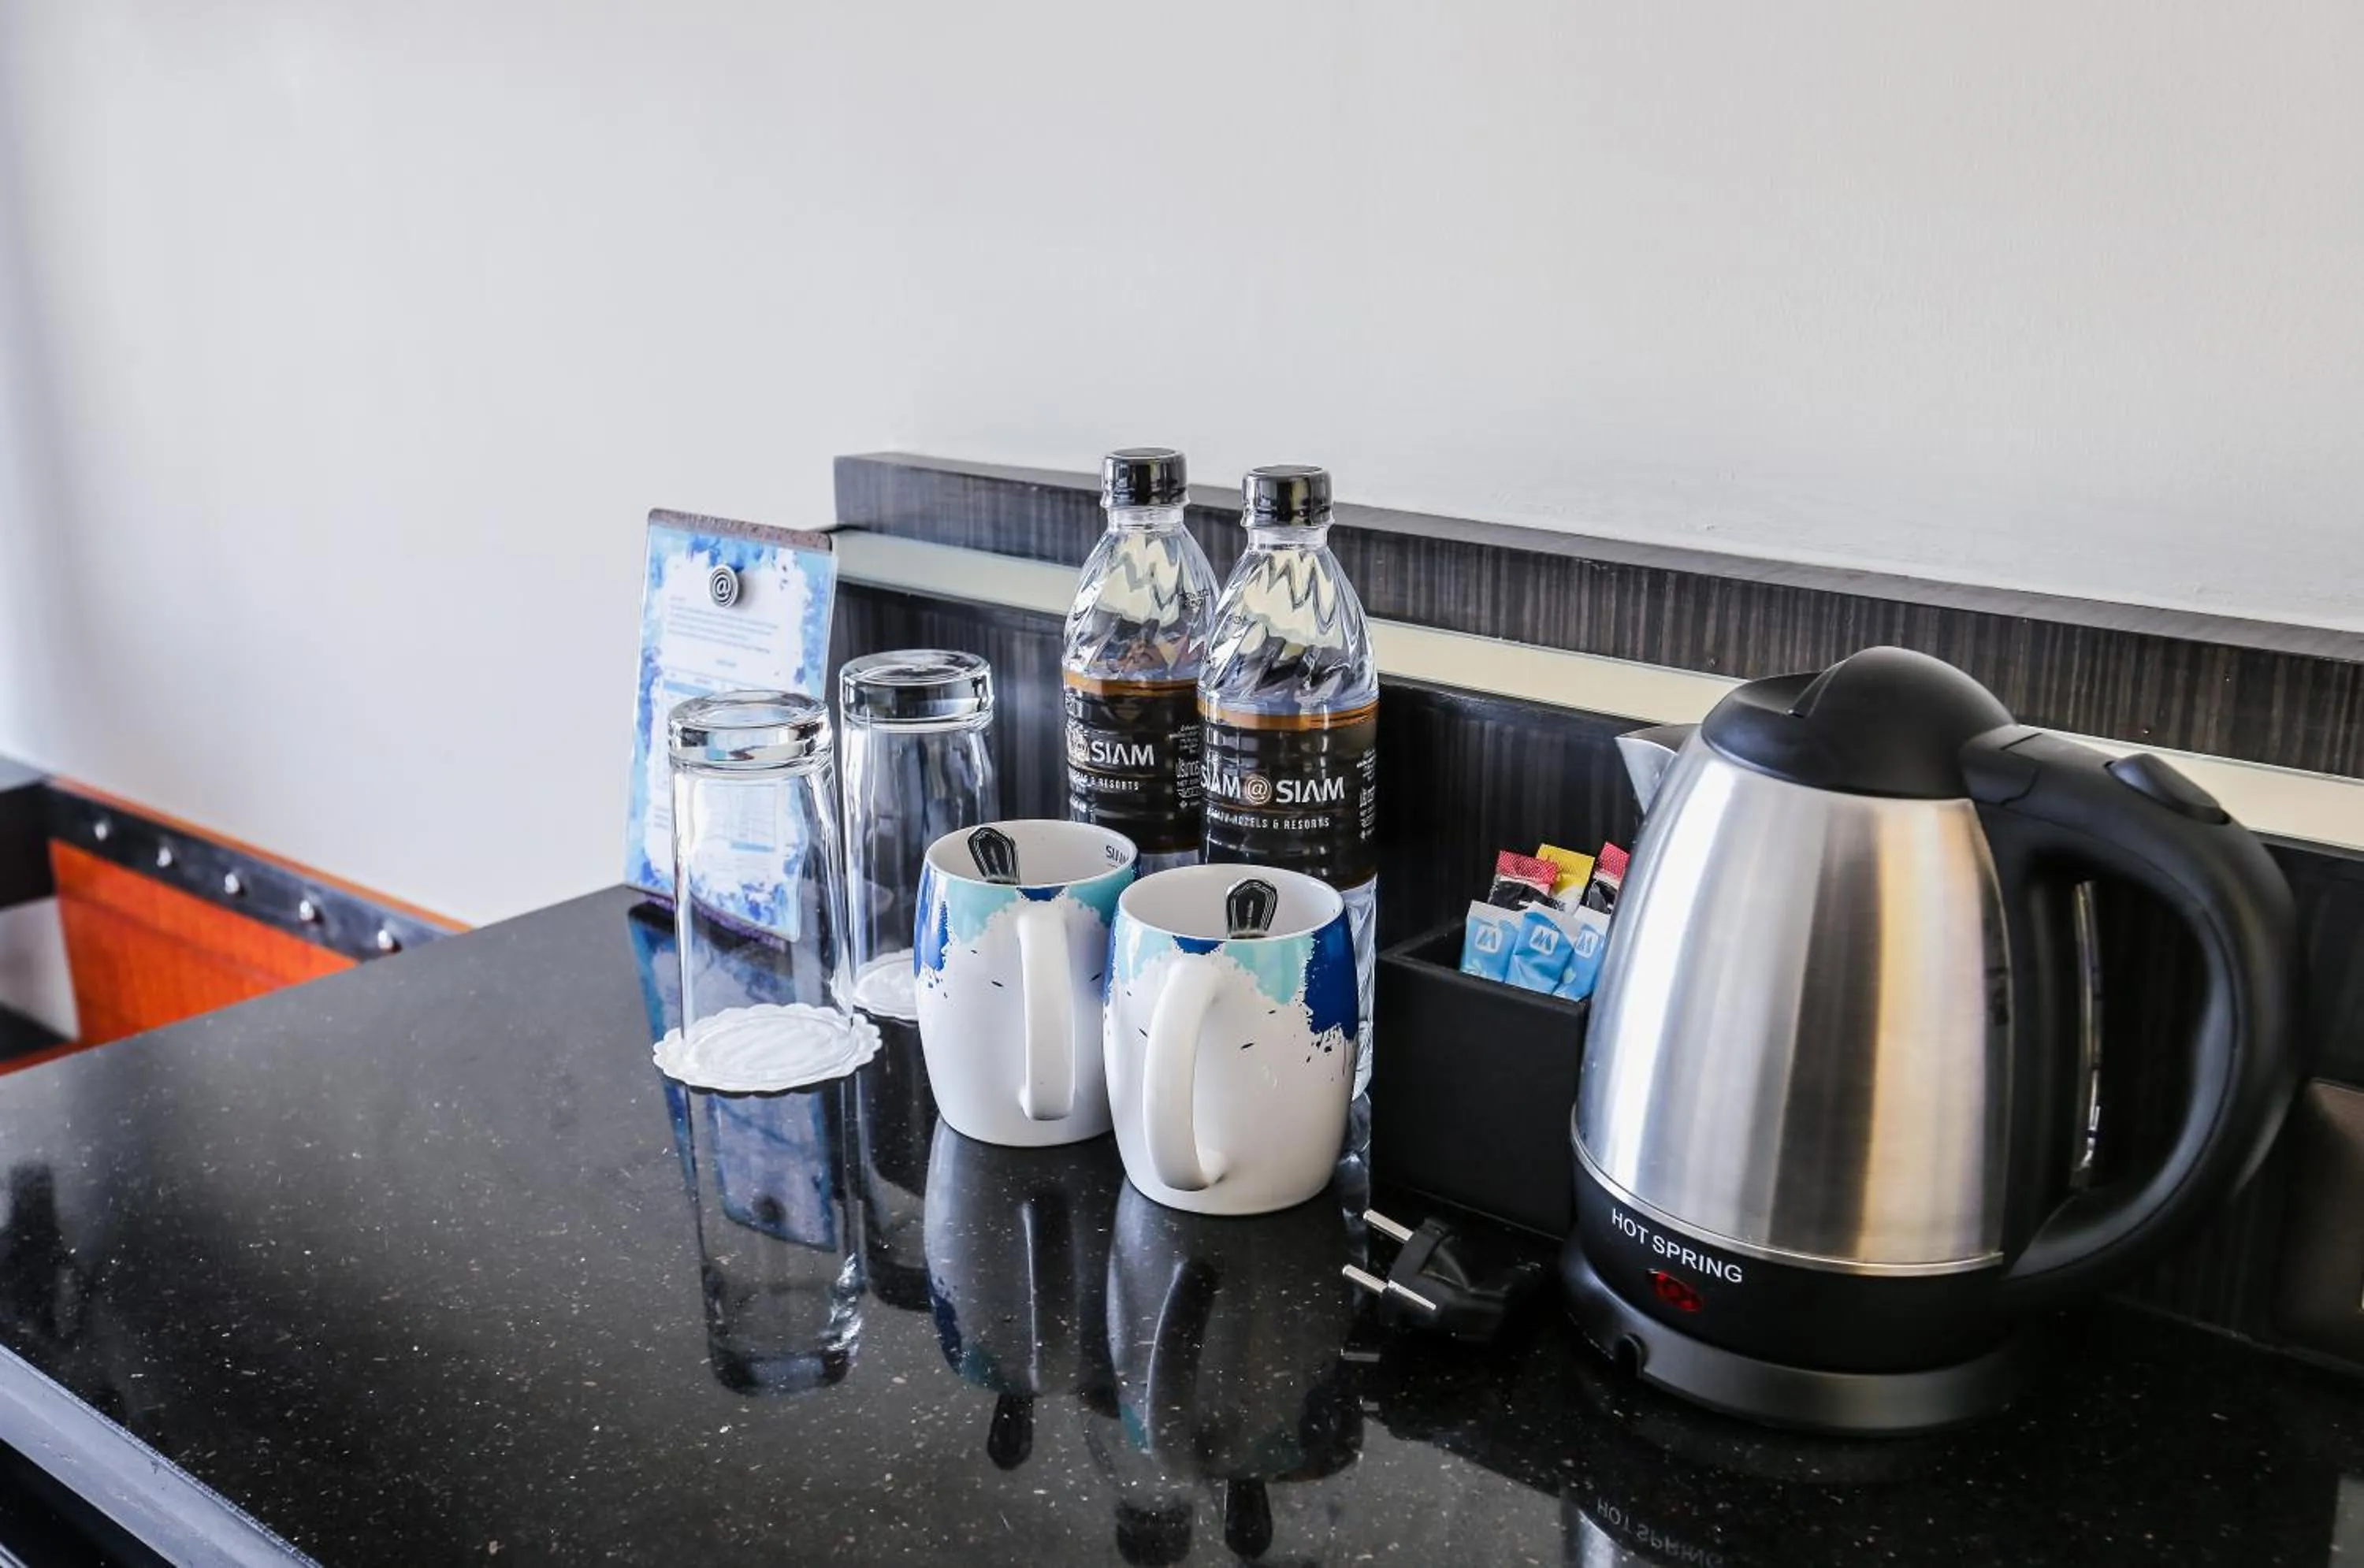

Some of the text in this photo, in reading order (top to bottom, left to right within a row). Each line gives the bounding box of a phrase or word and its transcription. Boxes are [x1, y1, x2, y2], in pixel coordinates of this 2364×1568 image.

[1091, 741, 1154, 766] SIAM
[1200, 765, 1241, 799] SIAM
[1276, 776, 1345, 803] SIAM
[1273, 819, 1279, 829] &
[1284, 817, 1330, 830] RESORTS
[1611, 1208, 1743, 1284] HOT SPRING
